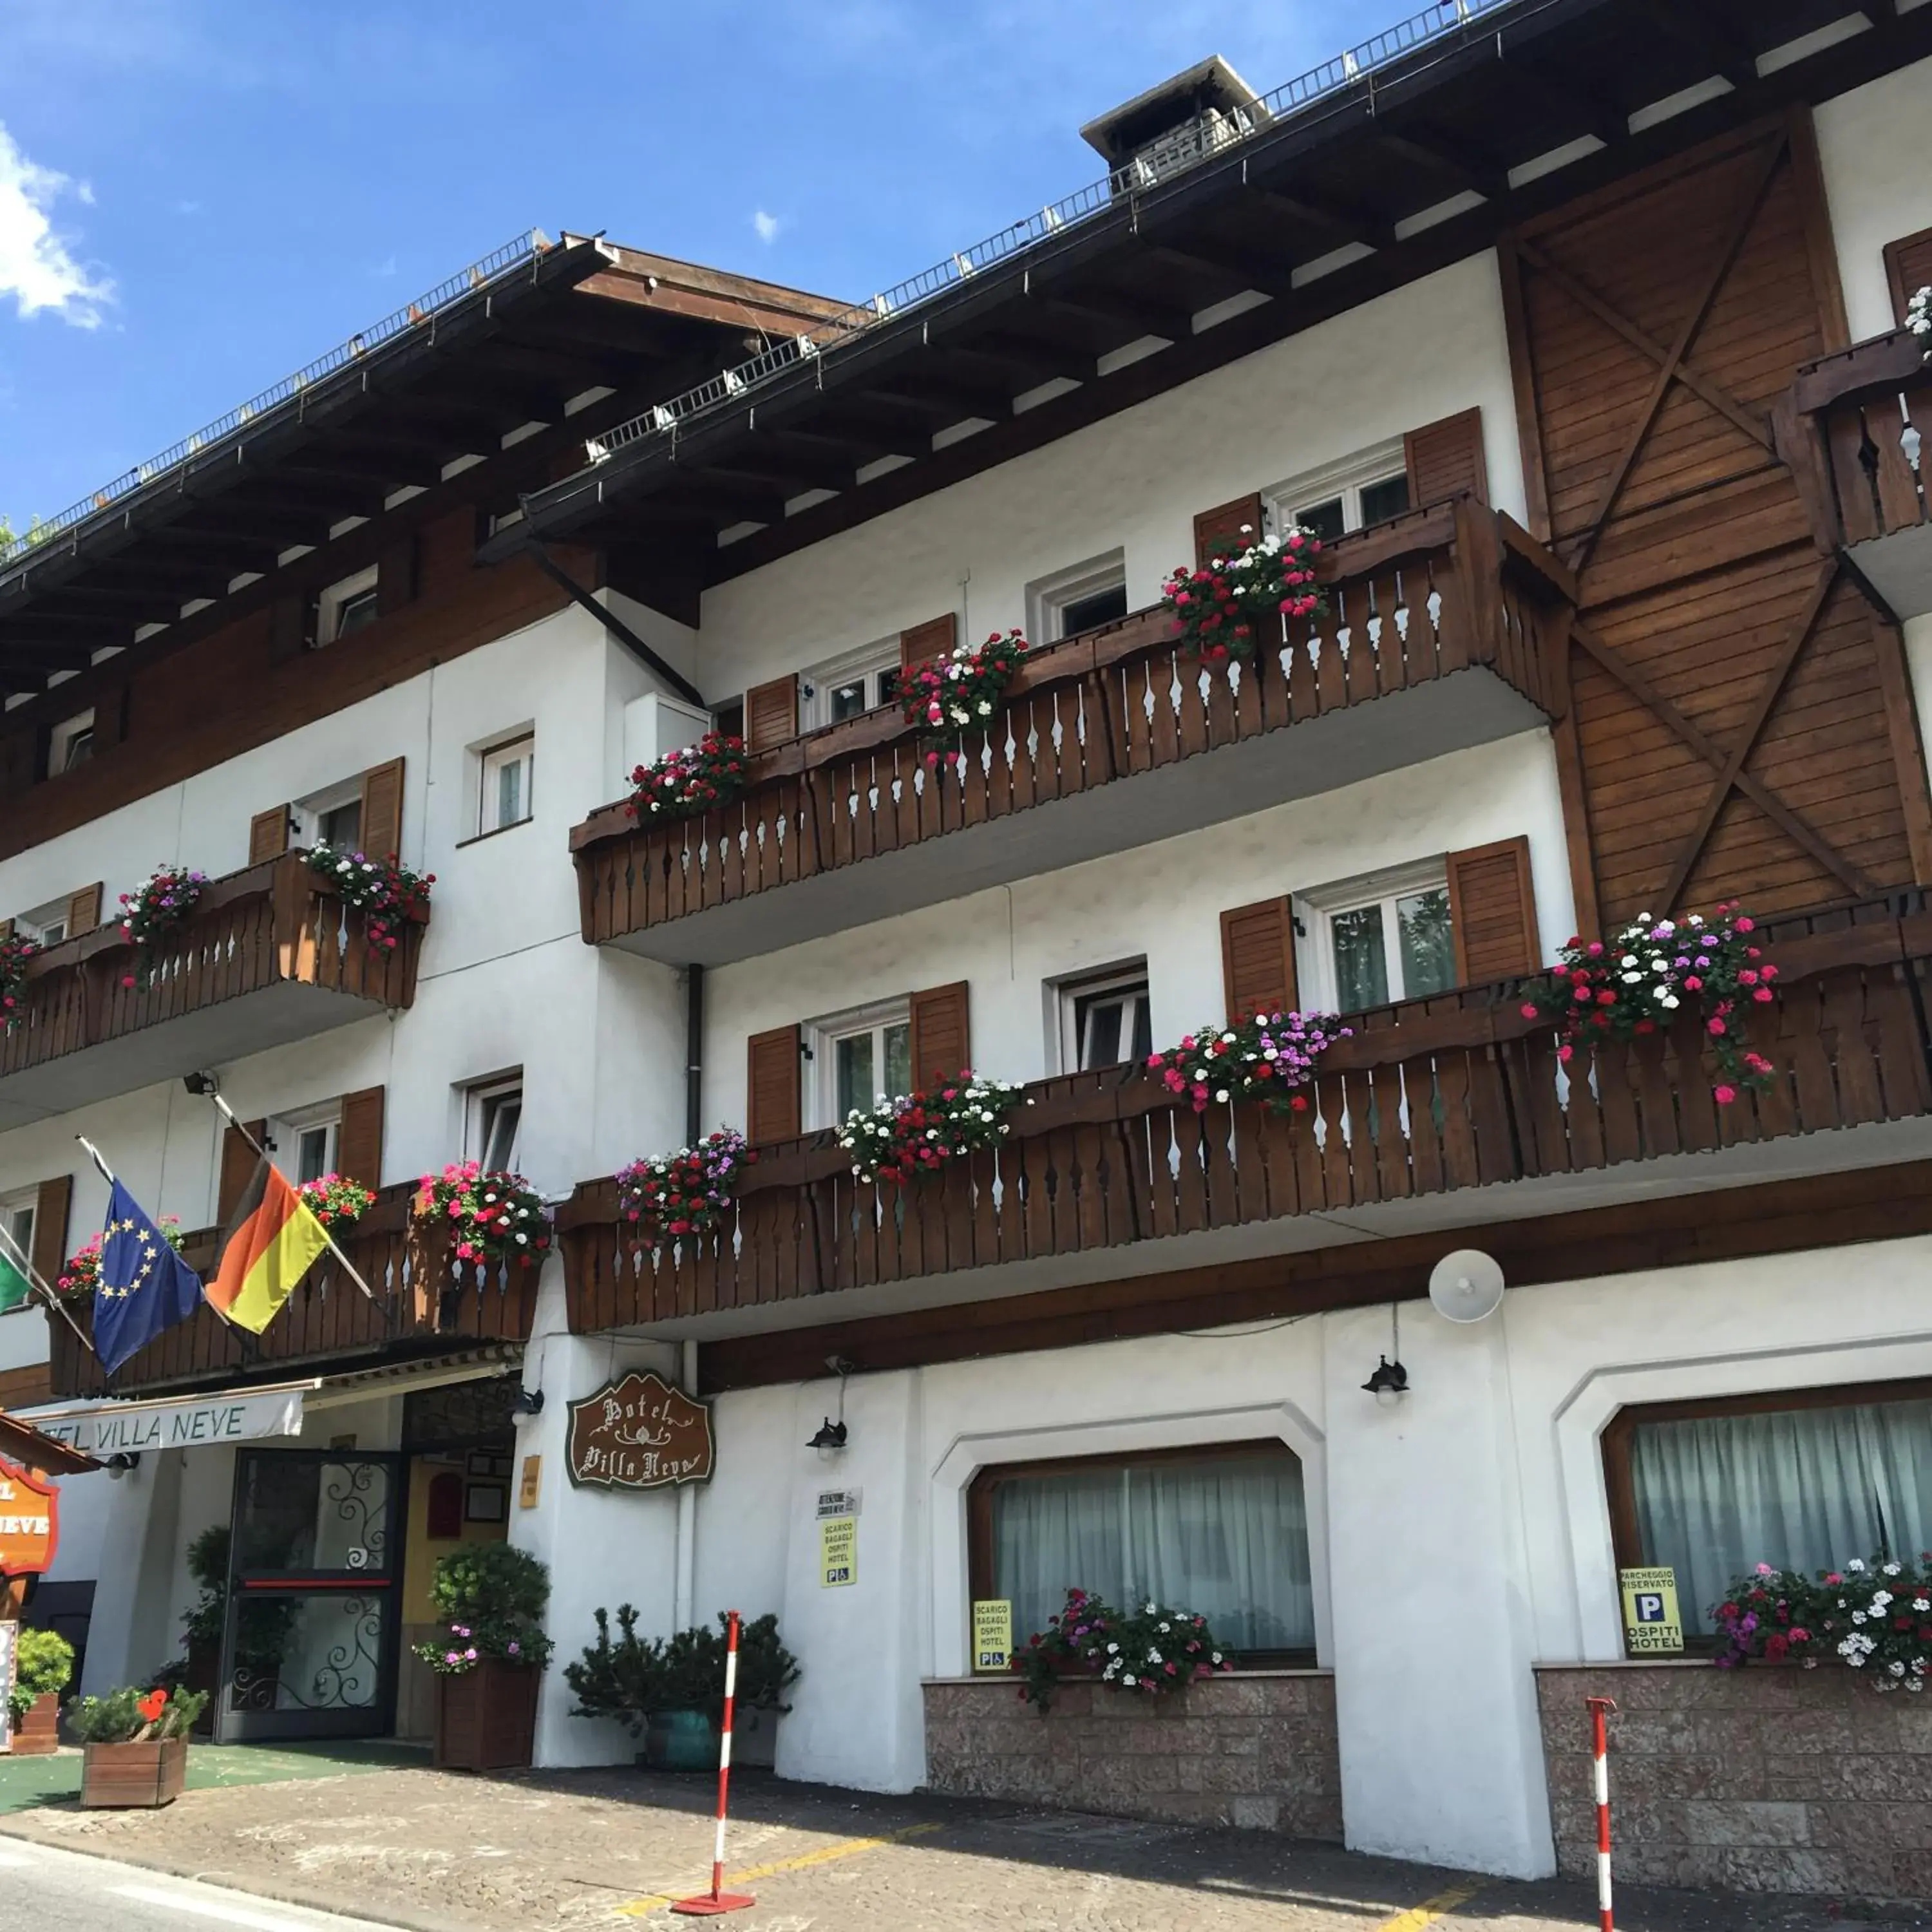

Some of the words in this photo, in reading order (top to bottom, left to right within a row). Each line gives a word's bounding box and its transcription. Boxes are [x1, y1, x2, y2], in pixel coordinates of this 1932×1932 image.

[592, 1394, 694, 1432] Hotel
[98, 1416, 160, 1448] VILLA
[172, 1406, 245, 1442] NEVE
[579, 1446, 634, 1476] Villa
[639, 1452, 701, 1481] Neve
[825, 1522, 853, 1534] SCARICO
[825, 1533, 853, 1544] BAGAGLI
[828, 1544, 848, 1553] OSPITI
[828, 1554, 849, 1564] HOTEL
[1622, 1571, 1672, 1580] PARCHEGGIO
[1621, 1580, 1674, 1589] RISERVATO
[976, 1605, 1008, 1614] SCARICO
[1641, 1596, 1660, 1620] P
[981, 1627, 1003, 1635] OSPITI
[1628, 1626, 1680, 1637] OSPITI
[981, 1638, 1004, 1646] HOTEL
[1630, 1638, 1682, 1649] HOTEL
